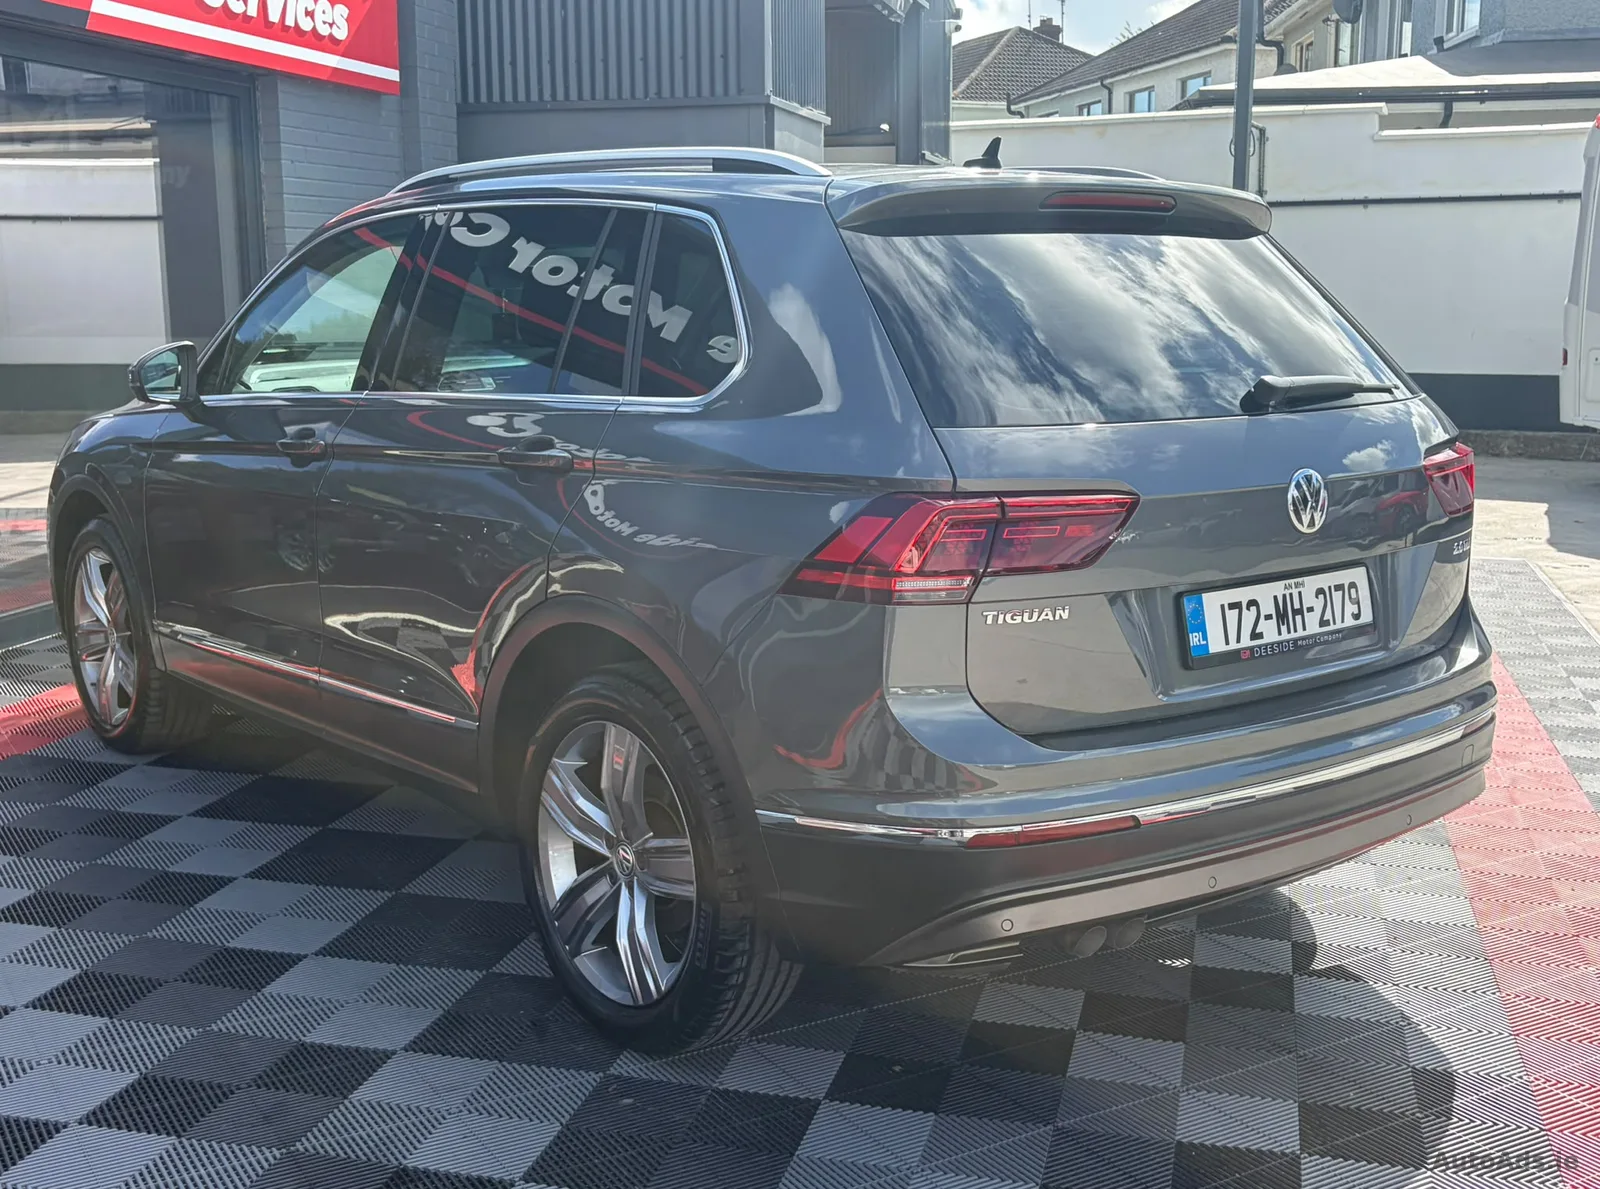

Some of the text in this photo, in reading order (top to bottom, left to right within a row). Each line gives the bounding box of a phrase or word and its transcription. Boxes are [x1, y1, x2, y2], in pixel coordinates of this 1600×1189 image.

[202, 0, 350, 41] rvices
[982, 605, 1070, 625] TIGUAN
[1219, 581, 1362, 647] 172-MH-2179
[1189, 632, 1207, 647] IRL
[1253, 632, 1343, 657] DEESIDE Motor Company
